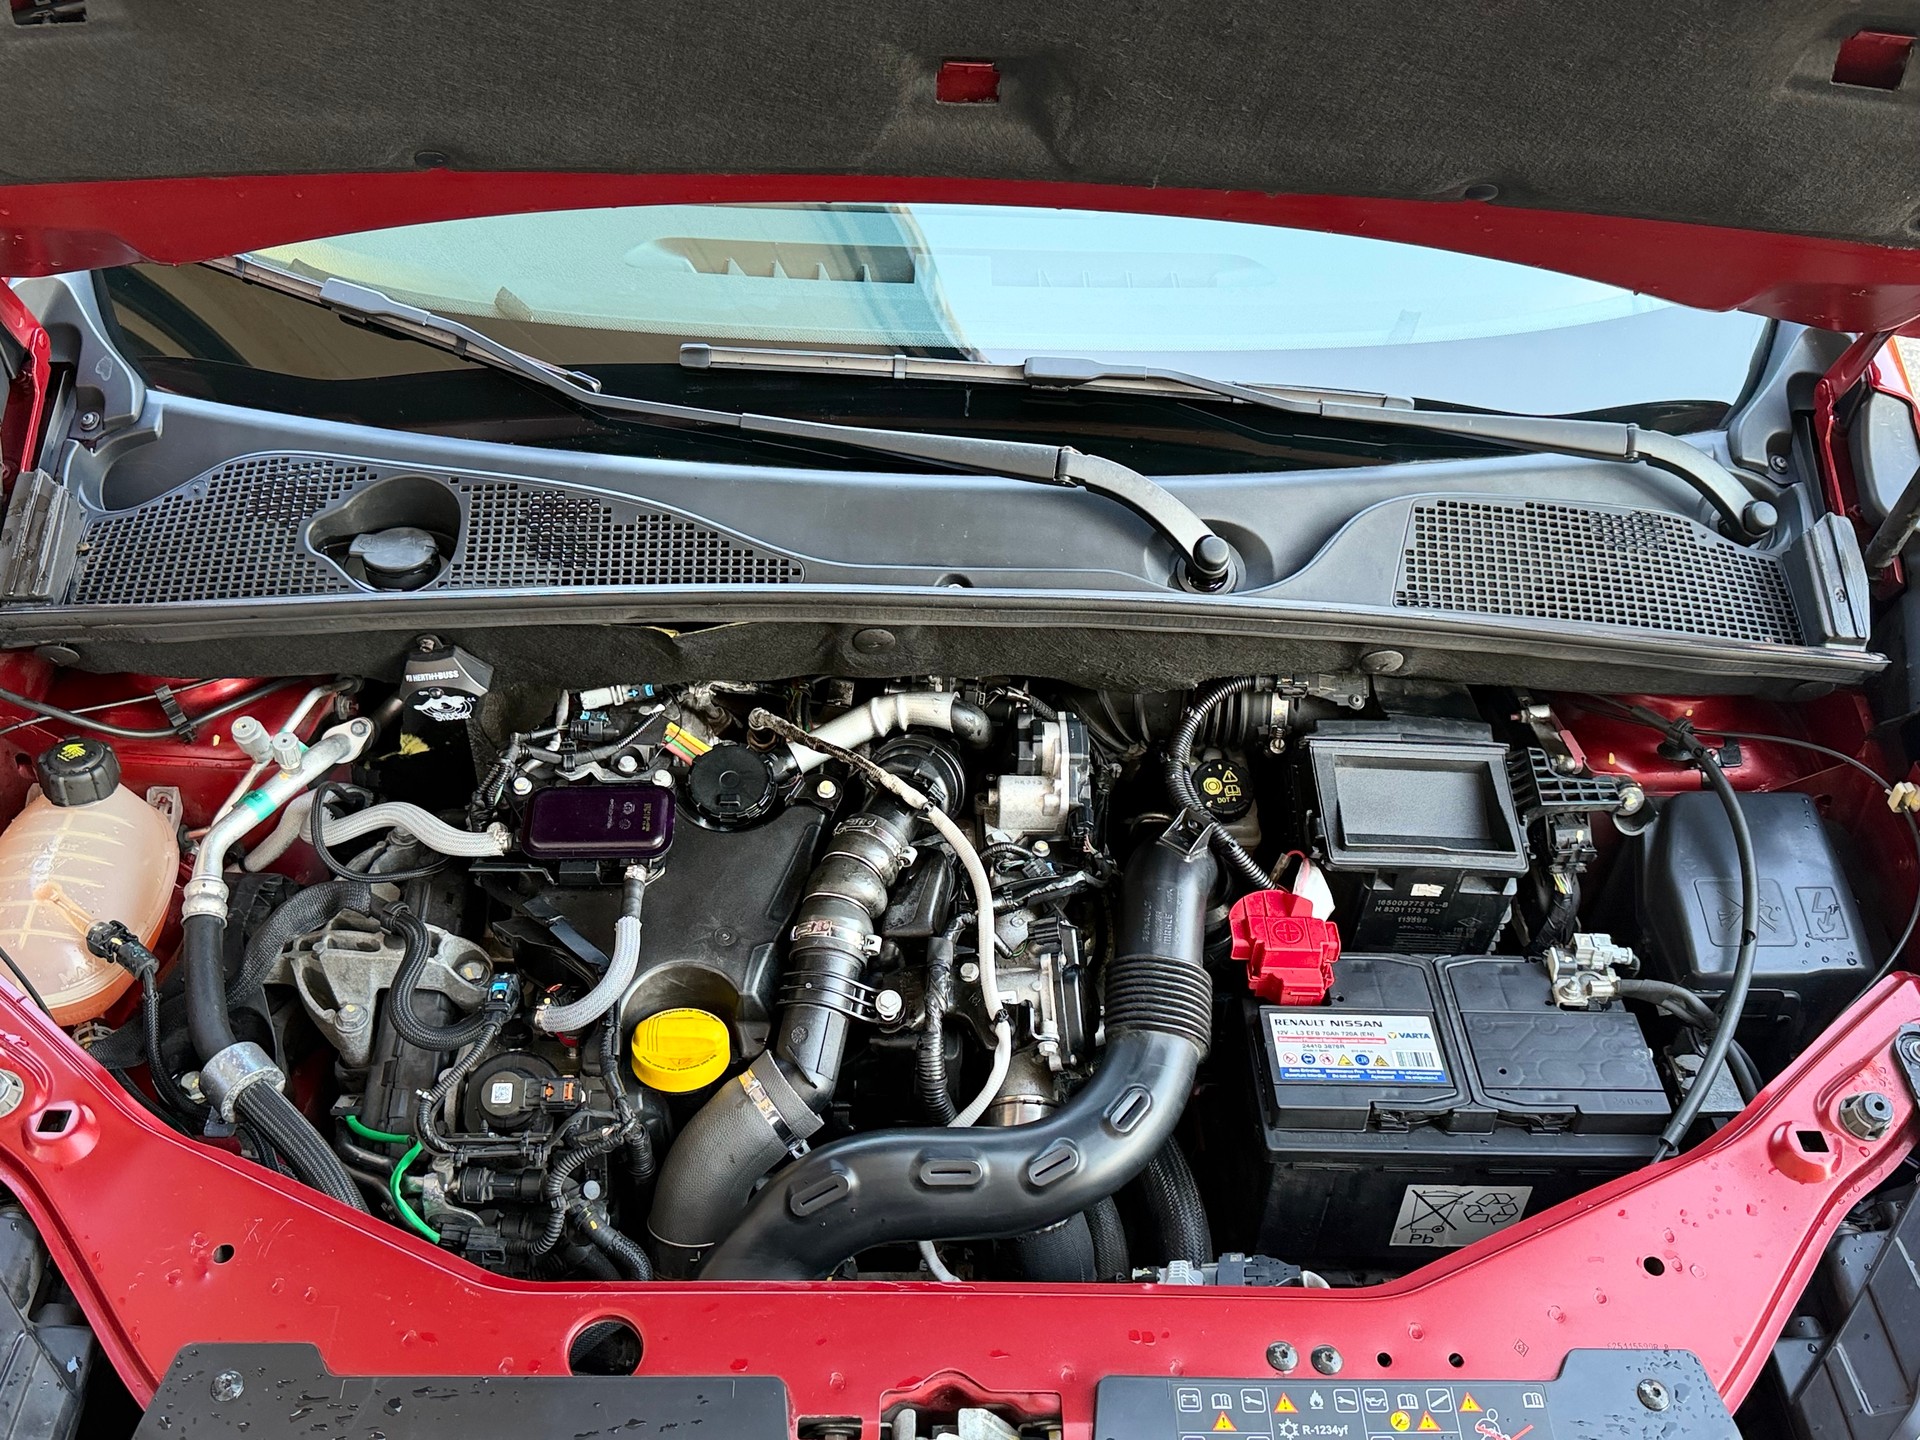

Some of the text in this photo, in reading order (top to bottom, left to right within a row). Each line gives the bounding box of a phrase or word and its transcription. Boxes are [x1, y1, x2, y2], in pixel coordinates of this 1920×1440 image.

[1274, 1018, 1383, 1028] RENAULT NISSAN
[1398, 1032, 1431, 1040] VARTA
[1409, 1233, 1435, 1244] Pb
[1302, 1424, 1349, 1437] R-1234yf
